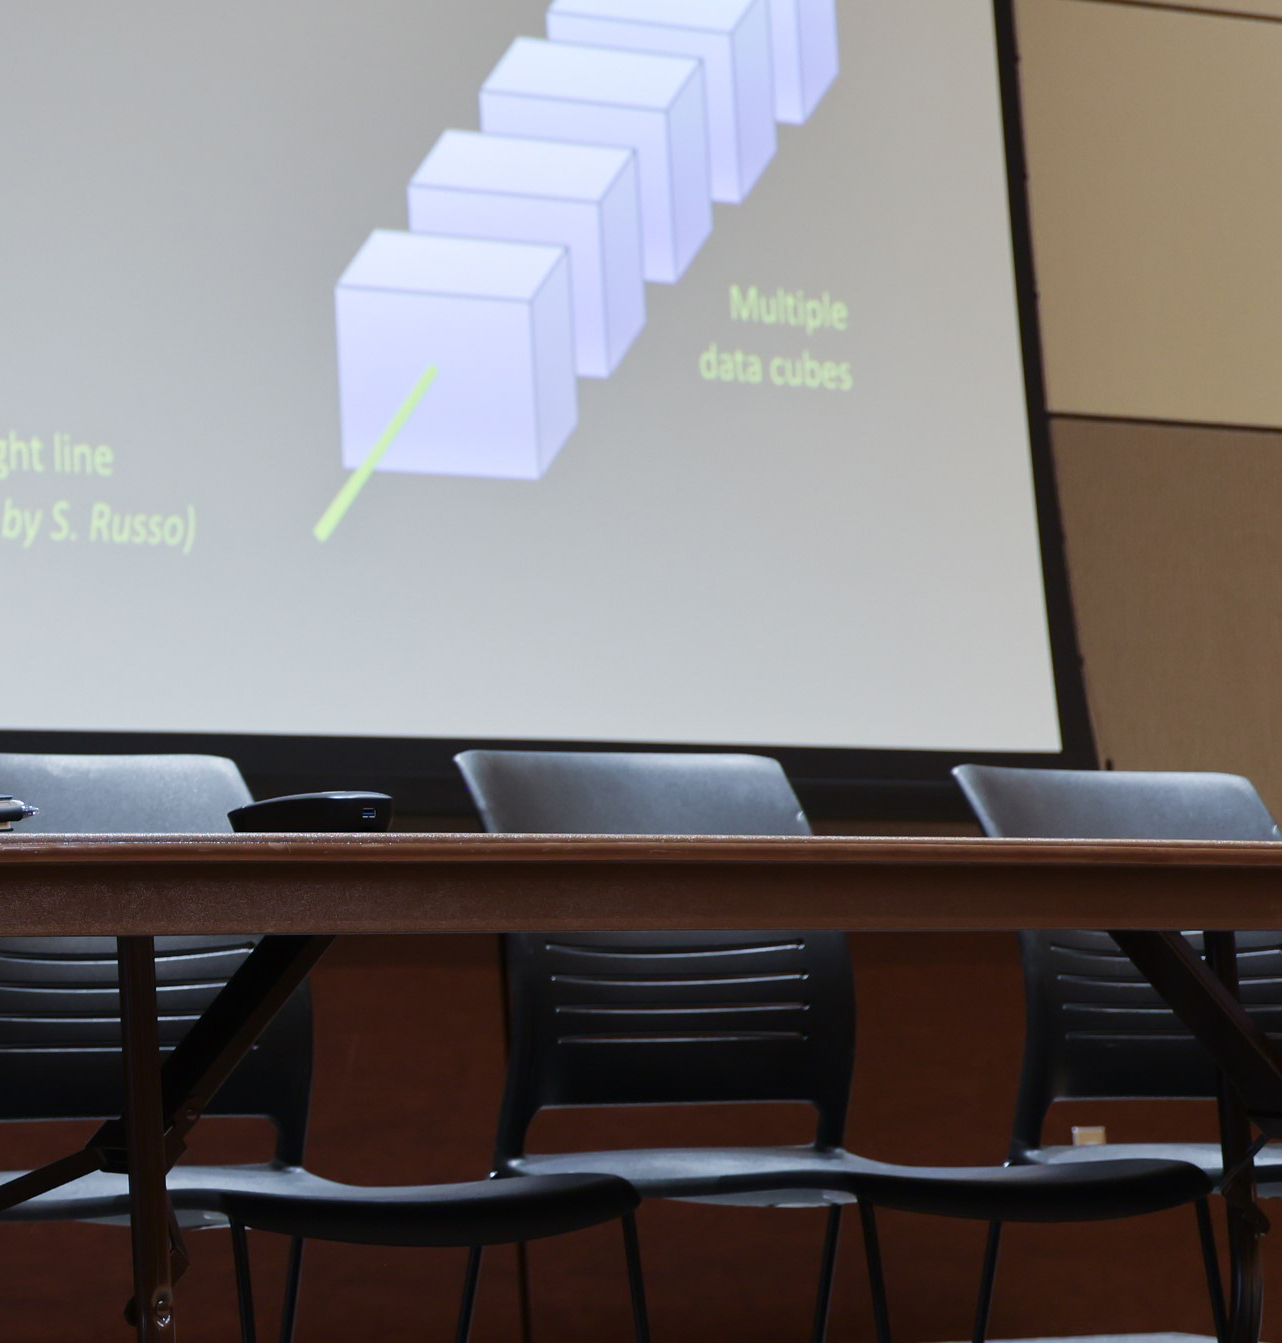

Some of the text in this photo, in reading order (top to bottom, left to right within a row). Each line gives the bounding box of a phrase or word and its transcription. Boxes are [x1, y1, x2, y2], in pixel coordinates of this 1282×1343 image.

[729, 284, 849, 336] Multiple
[699, 341, 854, 391] data cubes
[53, 432, 115, 477] line
[1, 498, 42, 549] by
[50, 500, 78, 542] S.
[89, 503, 196, 555] Russo)
